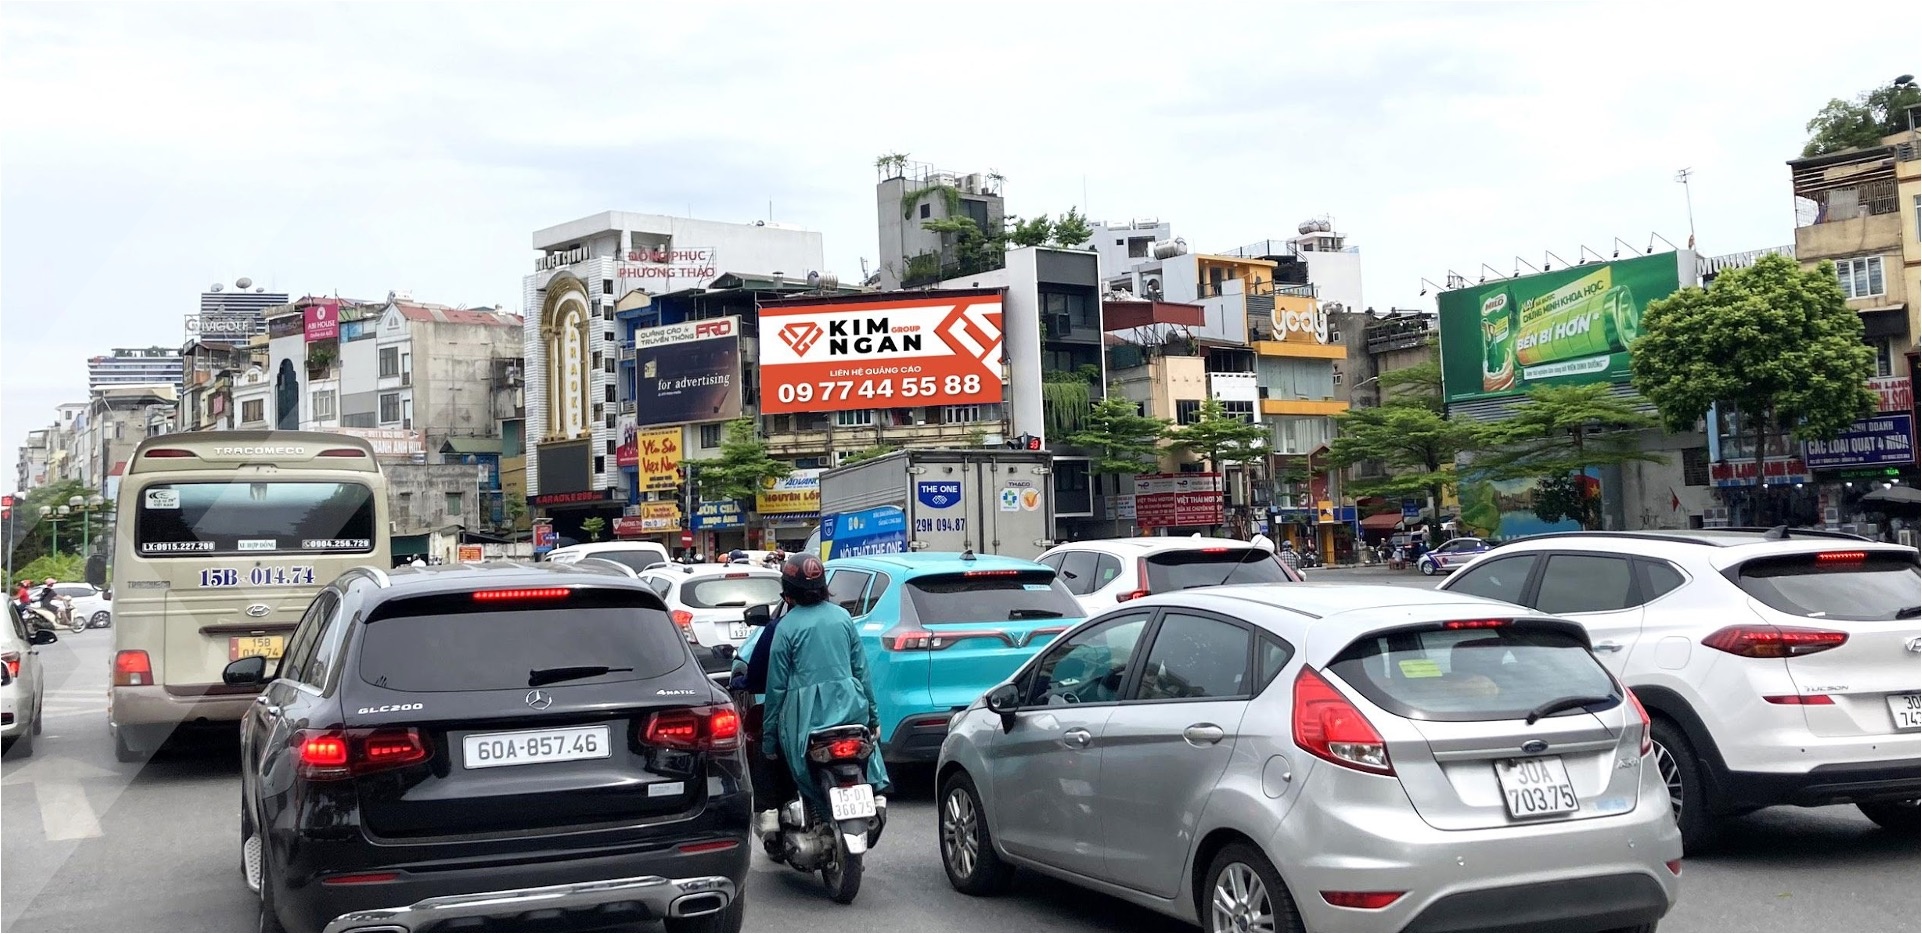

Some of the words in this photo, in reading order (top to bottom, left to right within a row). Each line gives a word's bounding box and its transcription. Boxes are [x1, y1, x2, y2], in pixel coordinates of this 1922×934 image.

[672, 250, 706, 264] PHỤC
[1696, 243, 1796, 275] MOUNTN
[619, 266, 676, 278] PHƯƠNG
[1560, 291, 1583, 308] KHOA
[1583, 280, 1605, 297] HỌC
[1485, 298, 1504, 311] MILO
[695, 320, 731, 338] PRO
[829, 317, 889, 337] KIM
[890, 325, 921, 334] GROUP
[1271, 304, 1328, 344] yody
[830, 334, 922, 356] NGAN
[569, 314, 578, 425] KARAOKE
[658, 378, 671, 391] for
[675, 372, 730, 389] advertising
[778, 381, 814, 403] 09
[819, 379, 853, 401] 77
[858, 377, 893, 398] 44
[902, 376, 937, 397] 55
[944, 373, 981, 395] 88
[1868, 421, 1894, 432] DOANH
[215, 447, 304, 455] TRACOMECO
[1851, 437, 1876, 454] QUẠT
[1878, 436, 1885, 450] 4
[1176, 496, 1189, 505] VIỆT
[916, 519, 932, 532] 29H
[936, 518, 965, 531] 094.87
[886, 541, 902, 553] ONE
[200, 569, 238, 587] 15B
[250, 566, 315, 584] 014.74
[252, 638, 271, 647] 15B
[242, 649, 279, 657] 01474
[478, 734, 597, 760] 60A-857.46
[1518, 759, 1553, 785] 30A
[1508, 783, 1575, 813] 703.75
